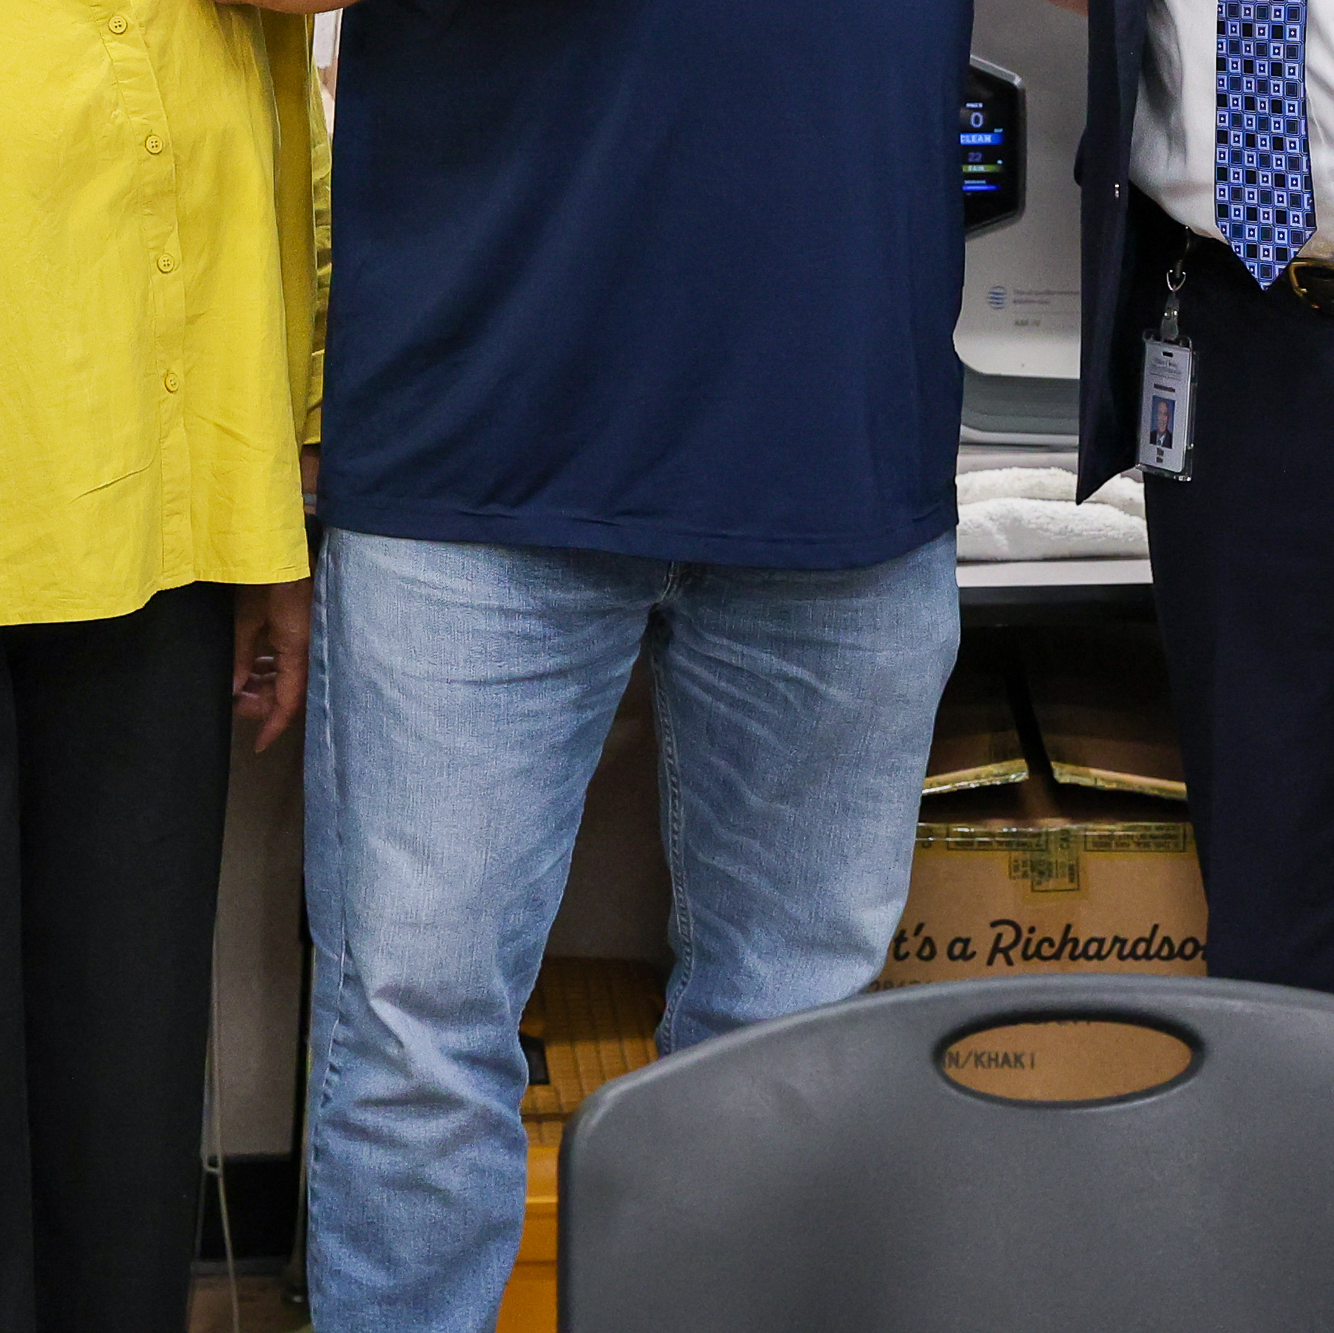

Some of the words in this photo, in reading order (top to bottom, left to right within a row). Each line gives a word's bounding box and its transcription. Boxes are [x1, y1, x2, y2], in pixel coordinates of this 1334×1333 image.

[893, 922, 937, 962] t's
[947, 936, 976, 962] a
[986, 918, 1208, 967] Richardso
